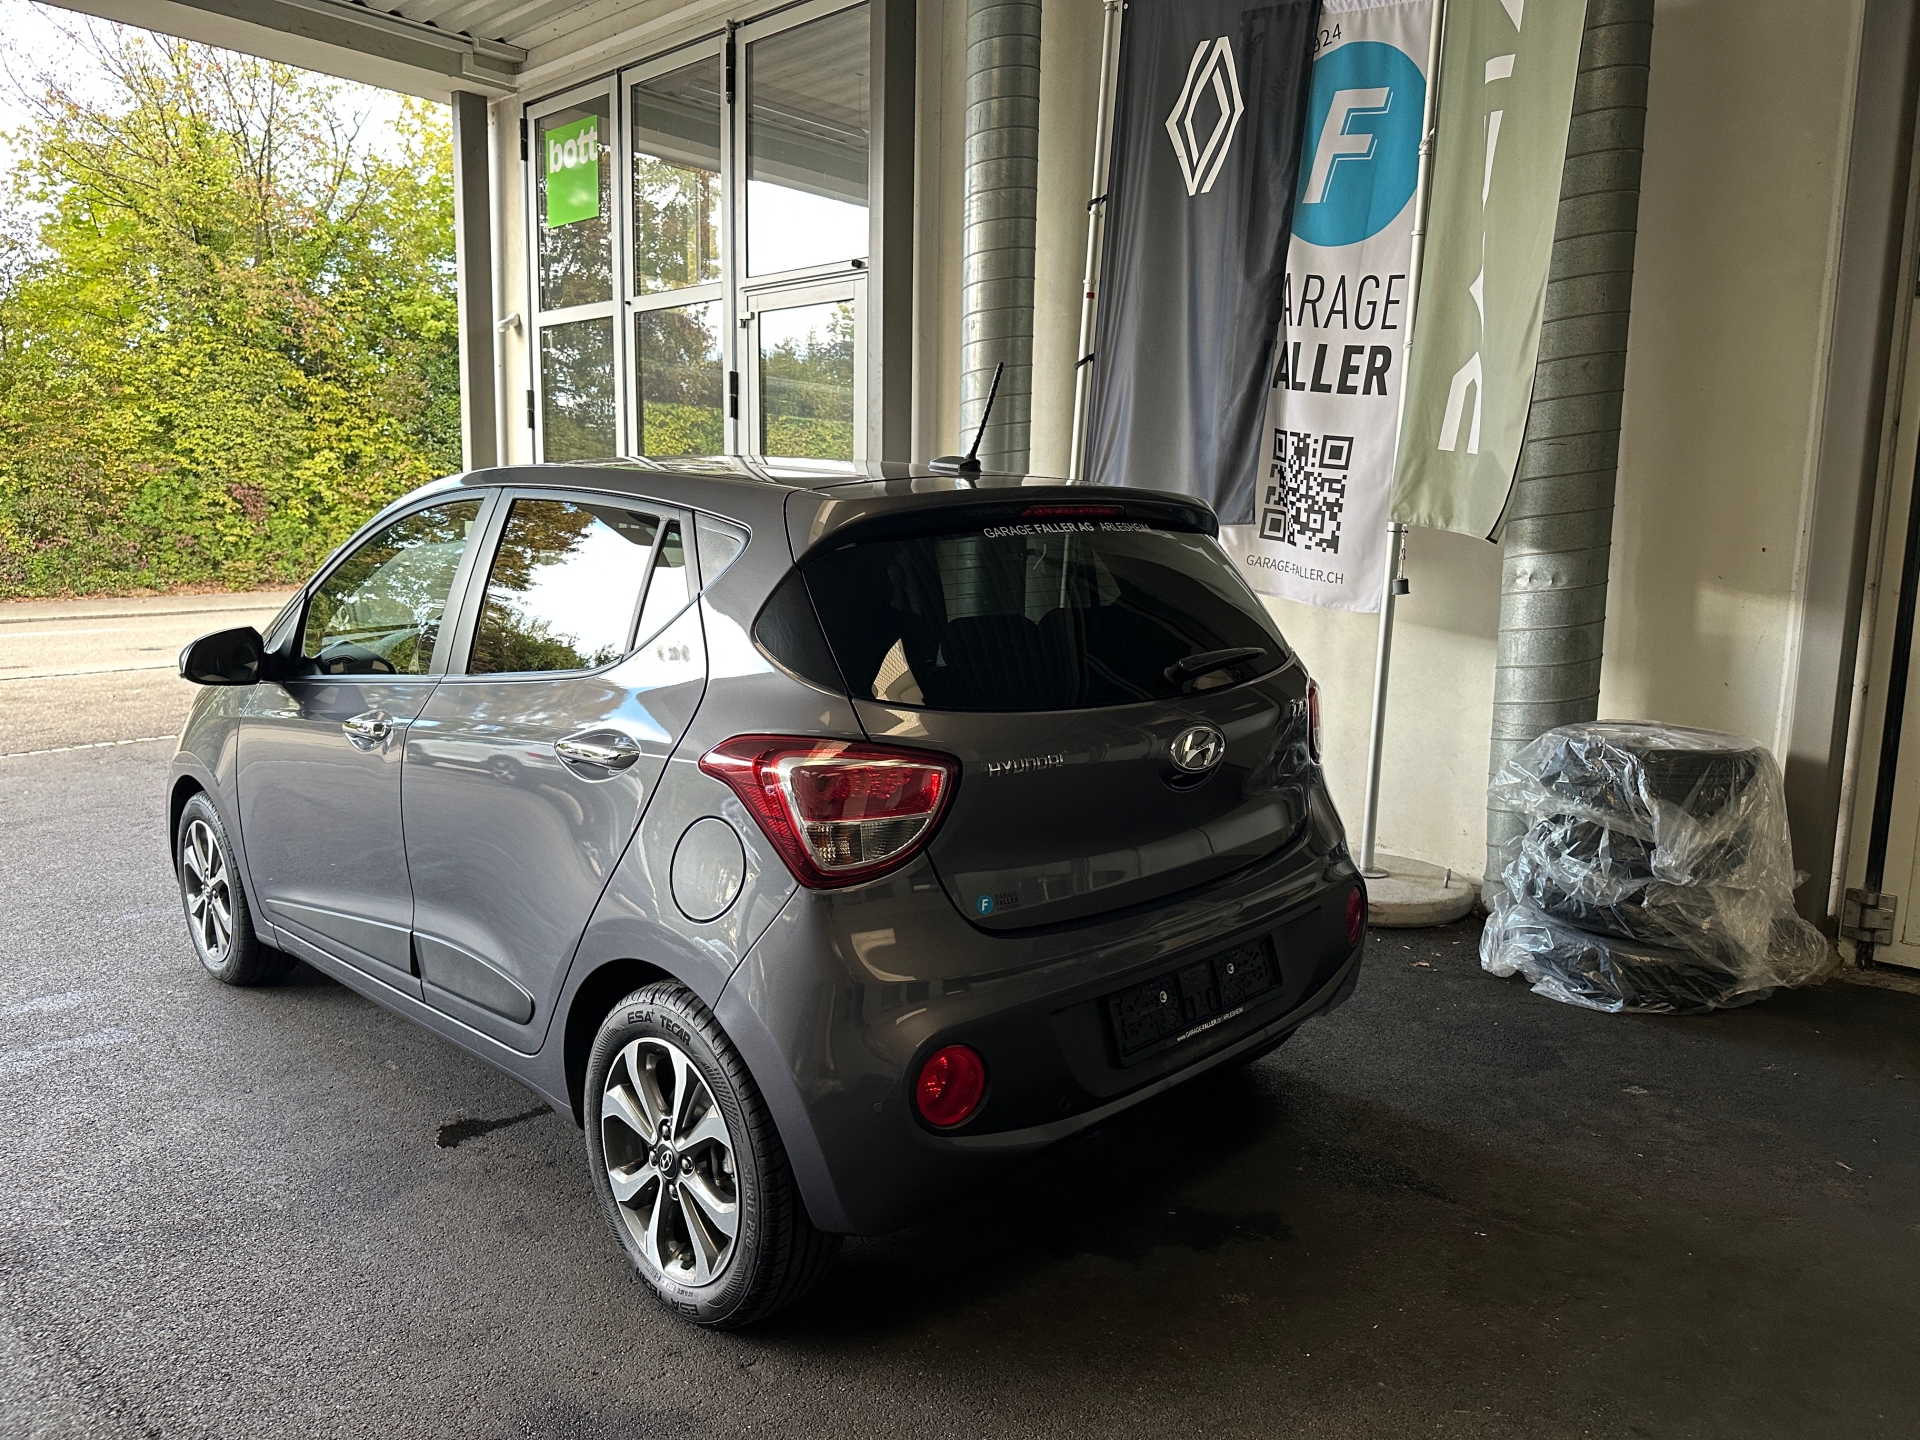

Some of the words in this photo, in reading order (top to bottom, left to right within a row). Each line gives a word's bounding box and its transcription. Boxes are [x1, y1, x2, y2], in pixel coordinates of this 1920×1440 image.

[1313, 23, 1342, 53] 924
[549, 126, 598, 174] bott
[1302, 87, 1395, 204] F
[1283, 272, 1406, 331] ARAGE
[1272, 341, 1393, 397] ALLER
[983, 523, 1036, 539] GARAGE
[1034, 522, 1079, 535] FALLER
[1078, 521, 1095, 533] AG
[1099, 521, 1152, 533] ARLESHEIM
[1245, 554, 1345, 585] GARAGE-FALLER.CH
[987, 752, 1065, 778] HYUNDAI
[981, 898, 989, 912] F
[995, 896, 1019, 907] FALLER
[660, 1015, 692, 1047] TECAR
[743, 1163, 756, 1214] SPIRIT
[745, 1219, 756, 1250] PRO
